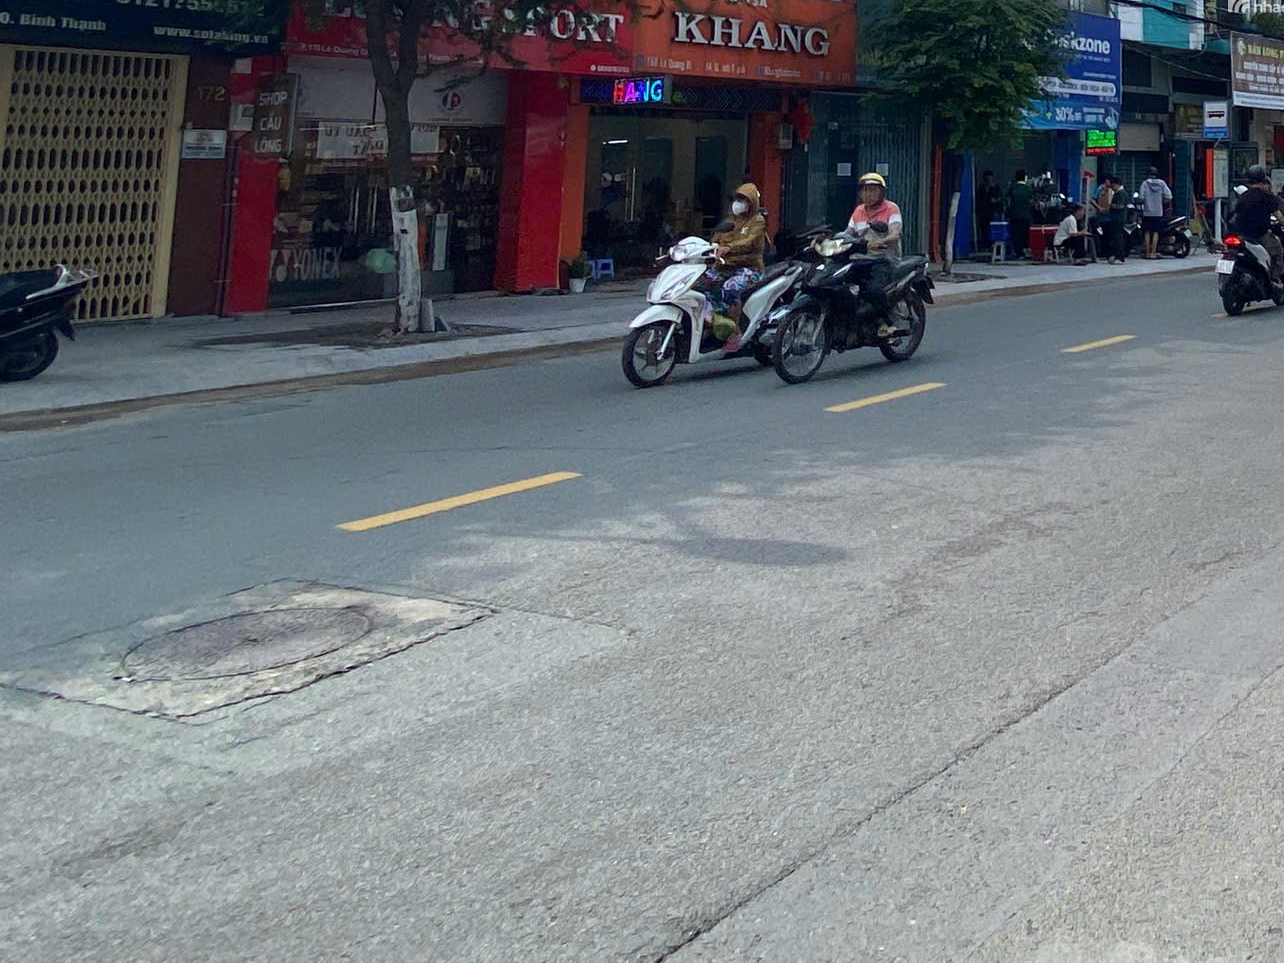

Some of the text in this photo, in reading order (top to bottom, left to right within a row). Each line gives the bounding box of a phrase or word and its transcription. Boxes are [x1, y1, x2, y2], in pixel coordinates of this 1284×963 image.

[673, 11, 831, 56] KHANG
[198, 85, 226, 102] 172
[259, 90, 289, 106] SHOP
[293, 245, 344, 281] YONEX
